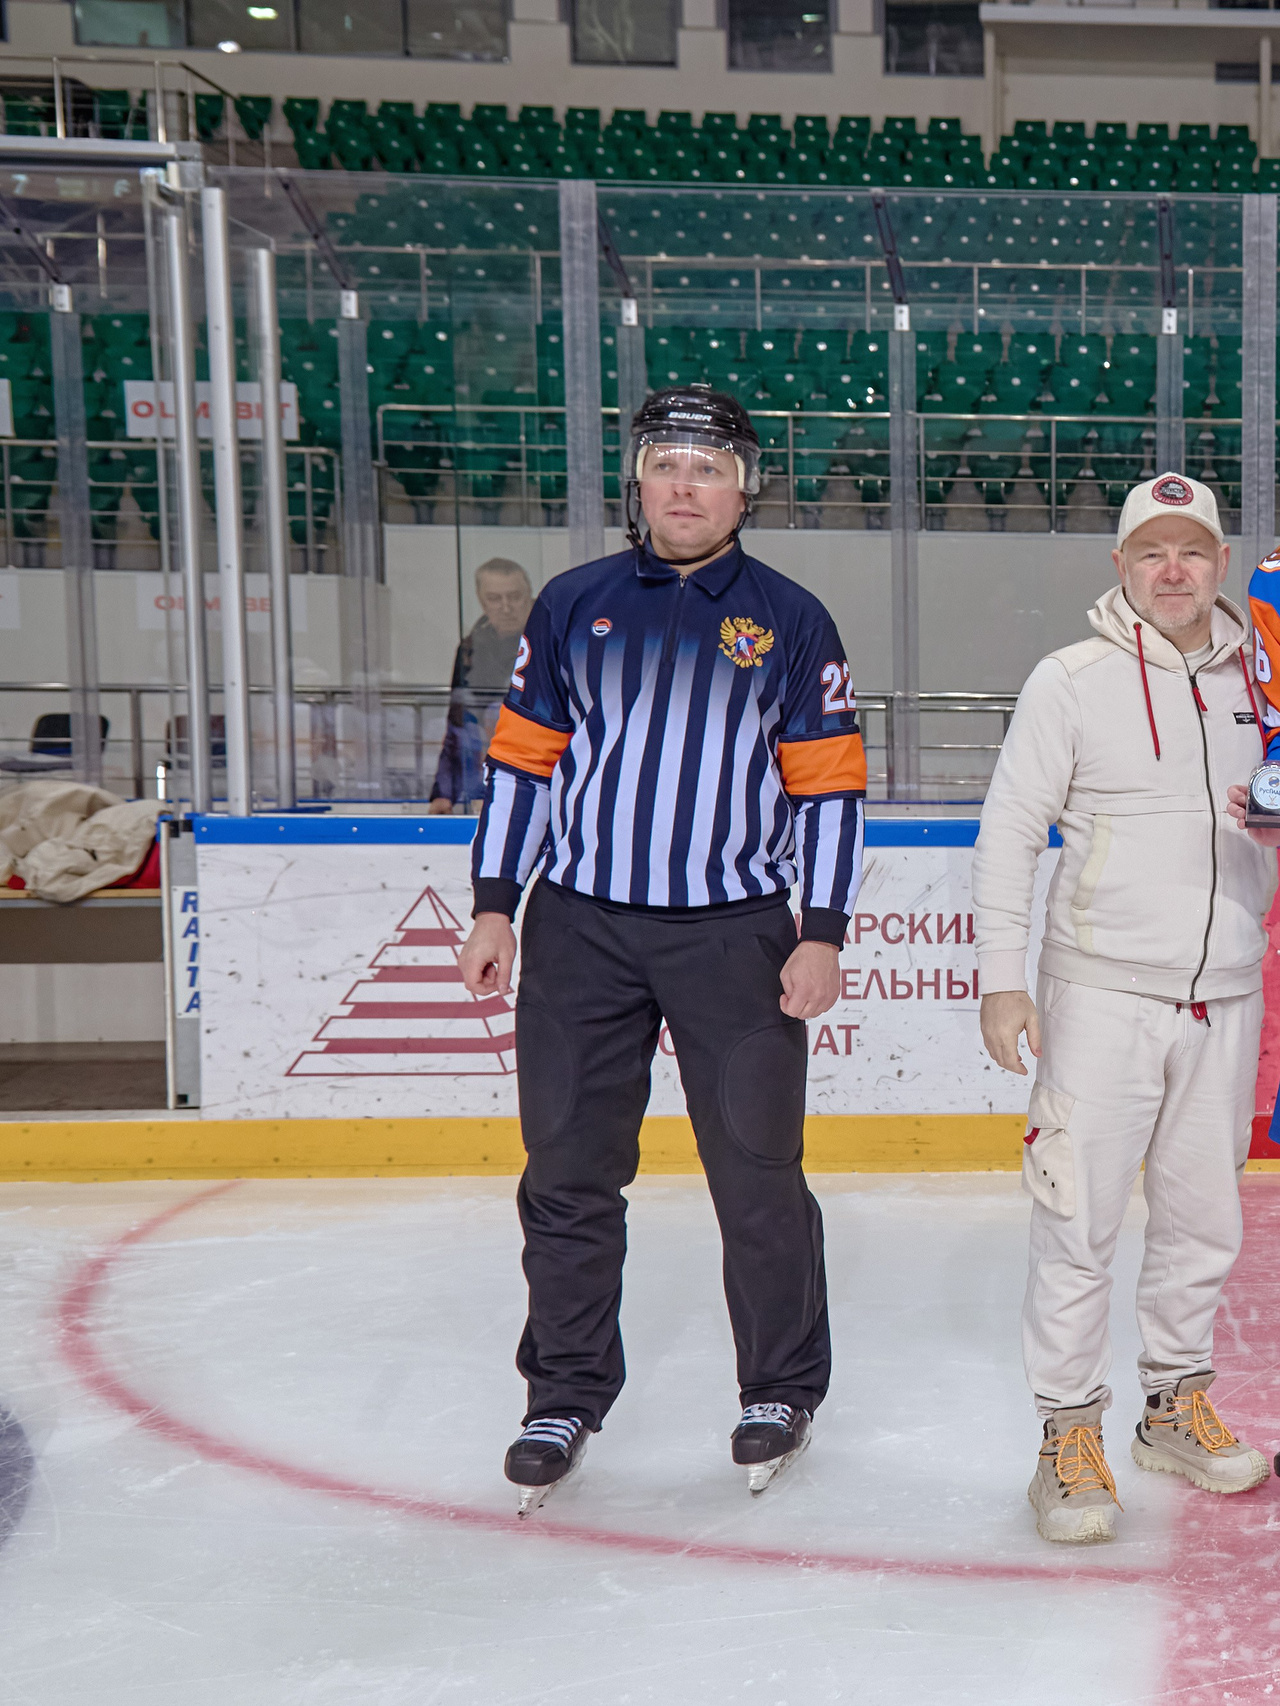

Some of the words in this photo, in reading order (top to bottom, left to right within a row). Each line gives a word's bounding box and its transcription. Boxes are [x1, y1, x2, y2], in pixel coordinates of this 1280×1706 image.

[131, 400, 291, 420] OLMBET
[667, 411, 713, 423] BAUER
[1254, 626, 1272, 683] 6
[840, 968, 979, 1000] ЕЛЬНЫ
